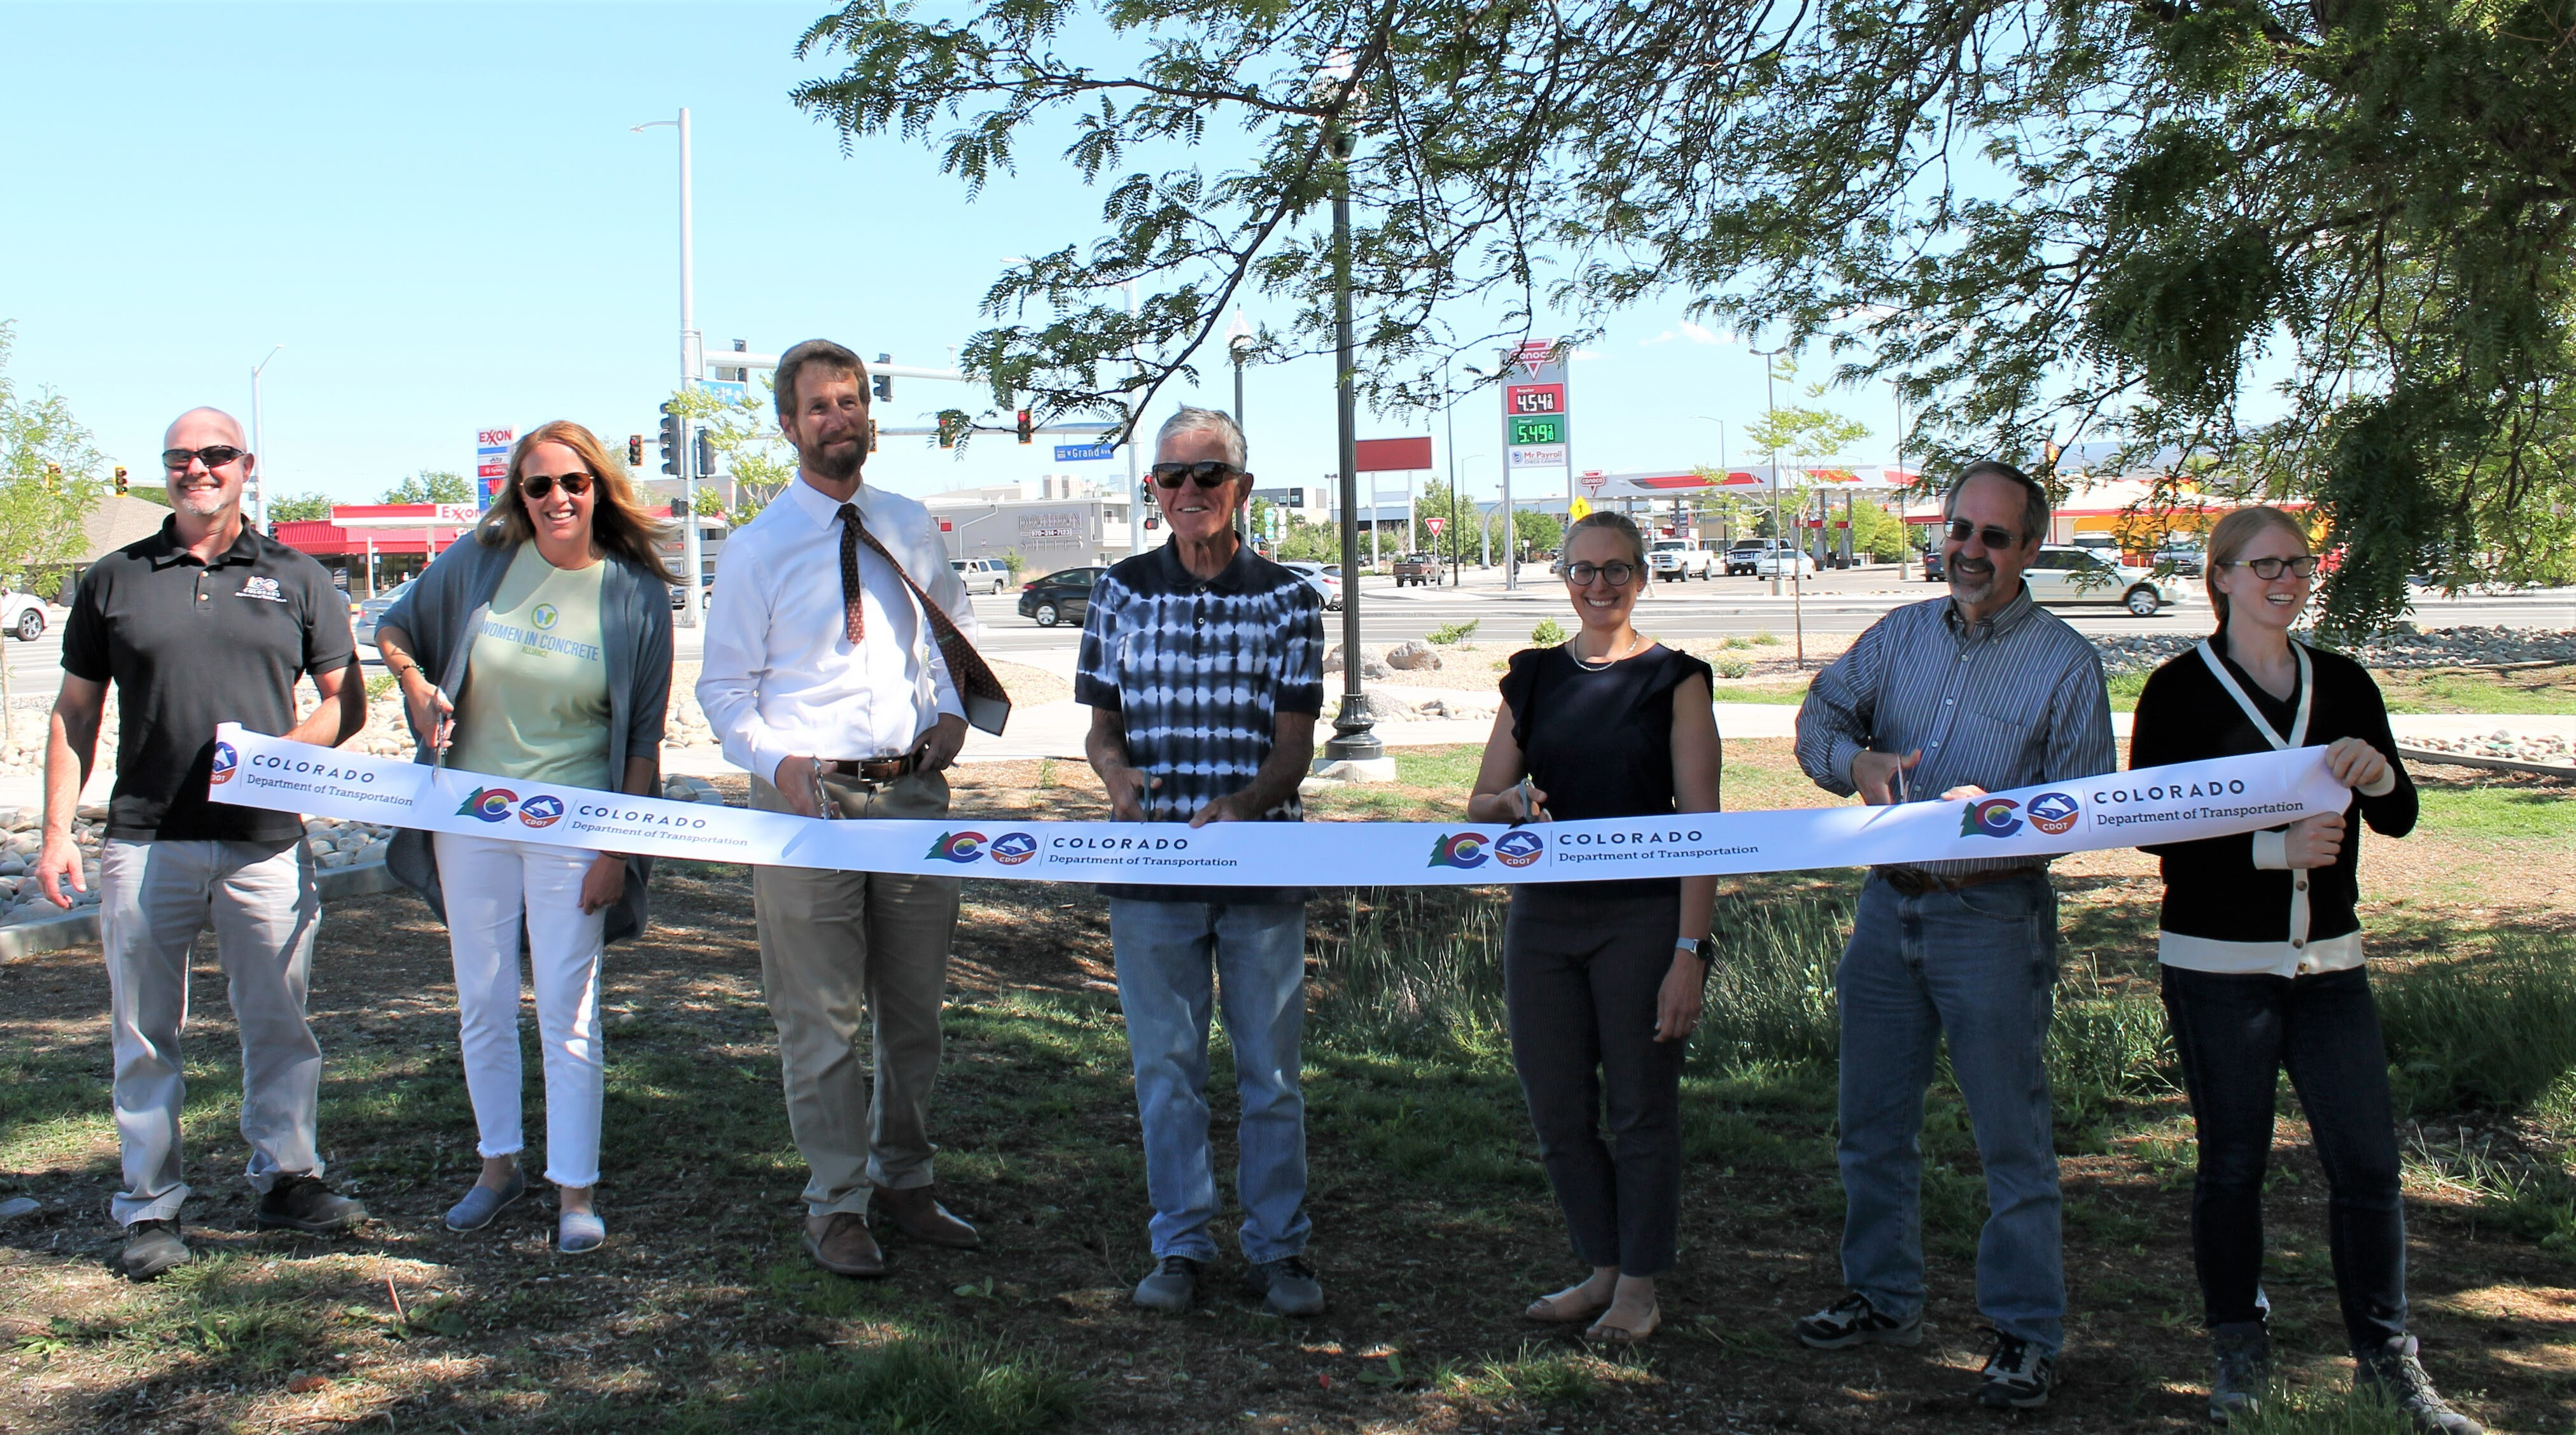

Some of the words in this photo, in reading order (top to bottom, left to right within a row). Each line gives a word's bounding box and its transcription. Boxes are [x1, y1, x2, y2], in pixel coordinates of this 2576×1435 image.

[479, 430, 512, 445] EXXON
[1072, 447, 1100, 458] Grand
[1536, 451, 1562, 459] Payroll
[1019, 512, 1082, 529] DOWNTOWN
[1020, 535, 1083, 552] SUITES
[480, 621, 523, 643] WOMEN
[524, 631, 539, 647] IN
[540, 634, 599, 661] CONCRETE
[521, 646, 549, 659] ALLIANCE
[253, 755, 375, 783] COLORADO
[247, 774, 312, 792] Department
[314, 785, 327, 794] of
[329, 786, 413, 806] Transportation
[2094, 780, 2244, 804] COLORADO
[579, 805, 706, 828] COLORADO
[2097, 810, 2179, 827] Department
[2183, 808, 2198, 819] of
[2199, 802, 2304, 818] Transportation
[572, 821, 642, 837] Department
[644, 830, 659, 838] of
[659, 832, 748, 846] Transportation
[2042, 822, 2068, 831] CDOT
[1053, 837, 1188, 850] COLORADO
[1559, 830, 1702, 844] COLORADO
[1049, 855, 1123, 865] Department
[1142, 857, 1238, 867] Transportation
[1559, 852, 1638, 863] Department
[1642, 850, 1655, 858] of
[1658, 846, 1759, 860] Transportation
